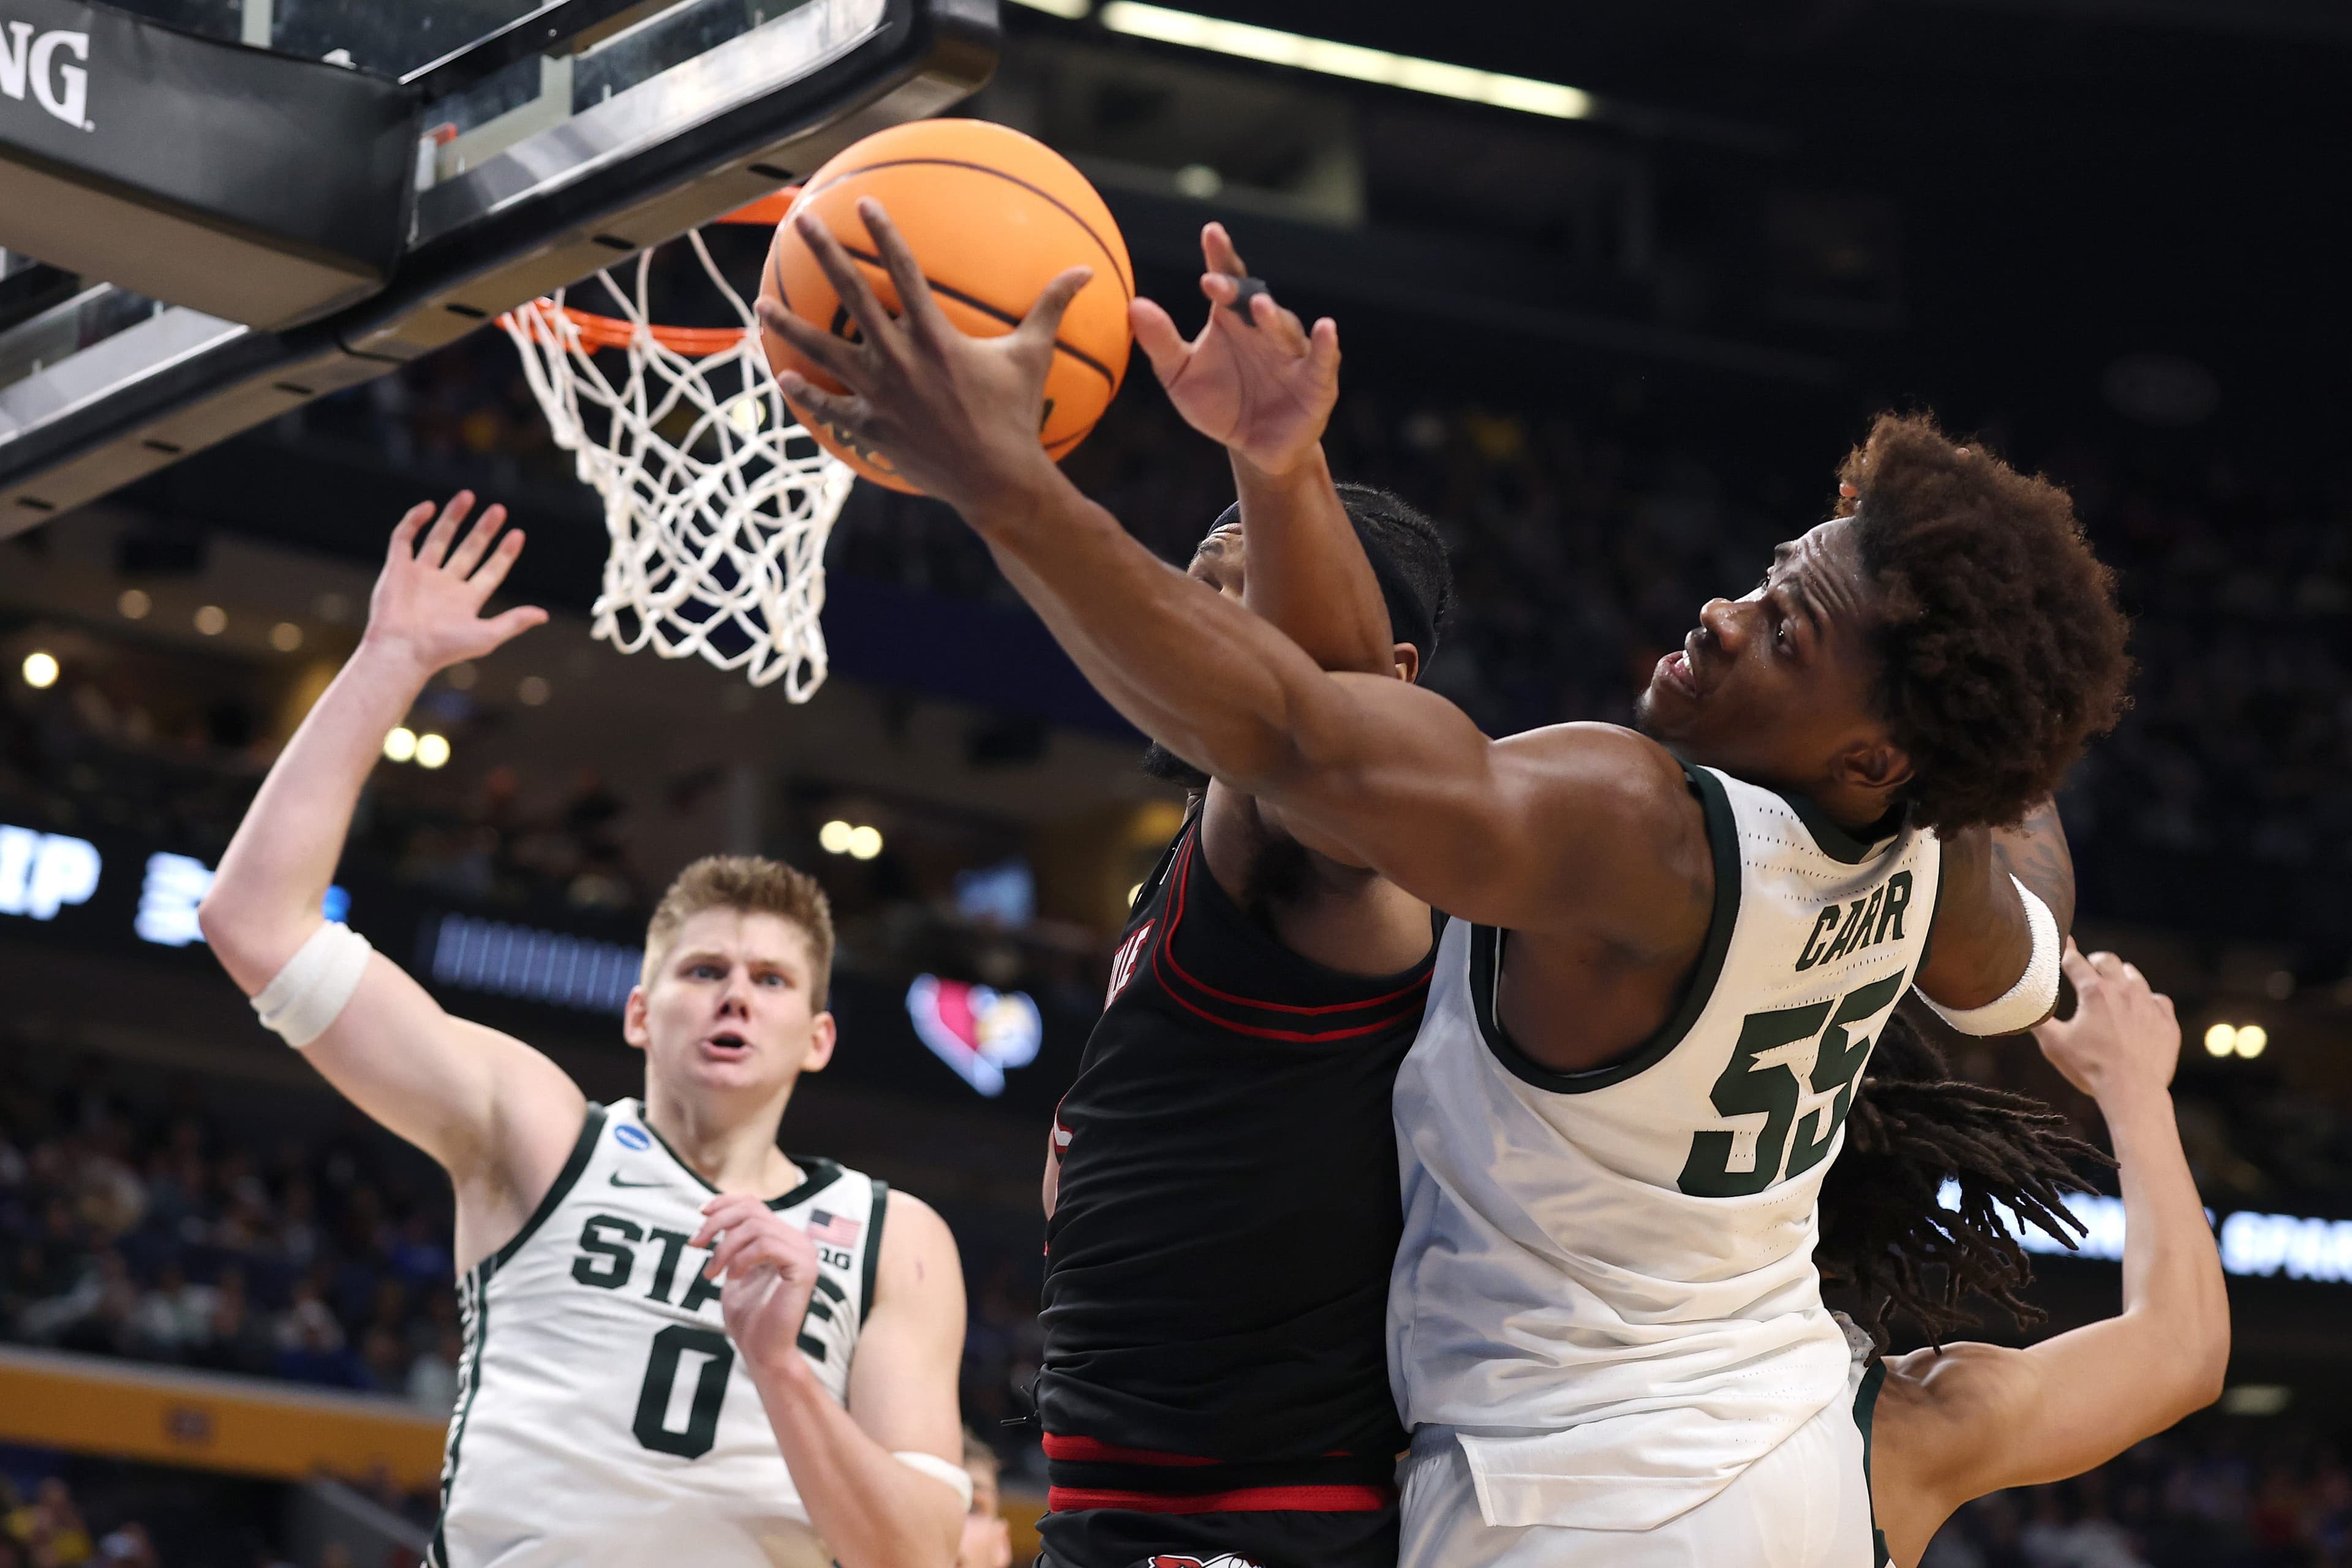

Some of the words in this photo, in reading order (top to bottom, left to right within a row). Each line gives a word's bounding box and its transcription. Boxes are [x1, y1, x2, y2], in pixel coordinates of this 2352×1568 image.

[1795, 870, 1913, 972] CARR
[1676, 965, 1907, 1198] 55
[633, 1324, 735, 1460] 0
